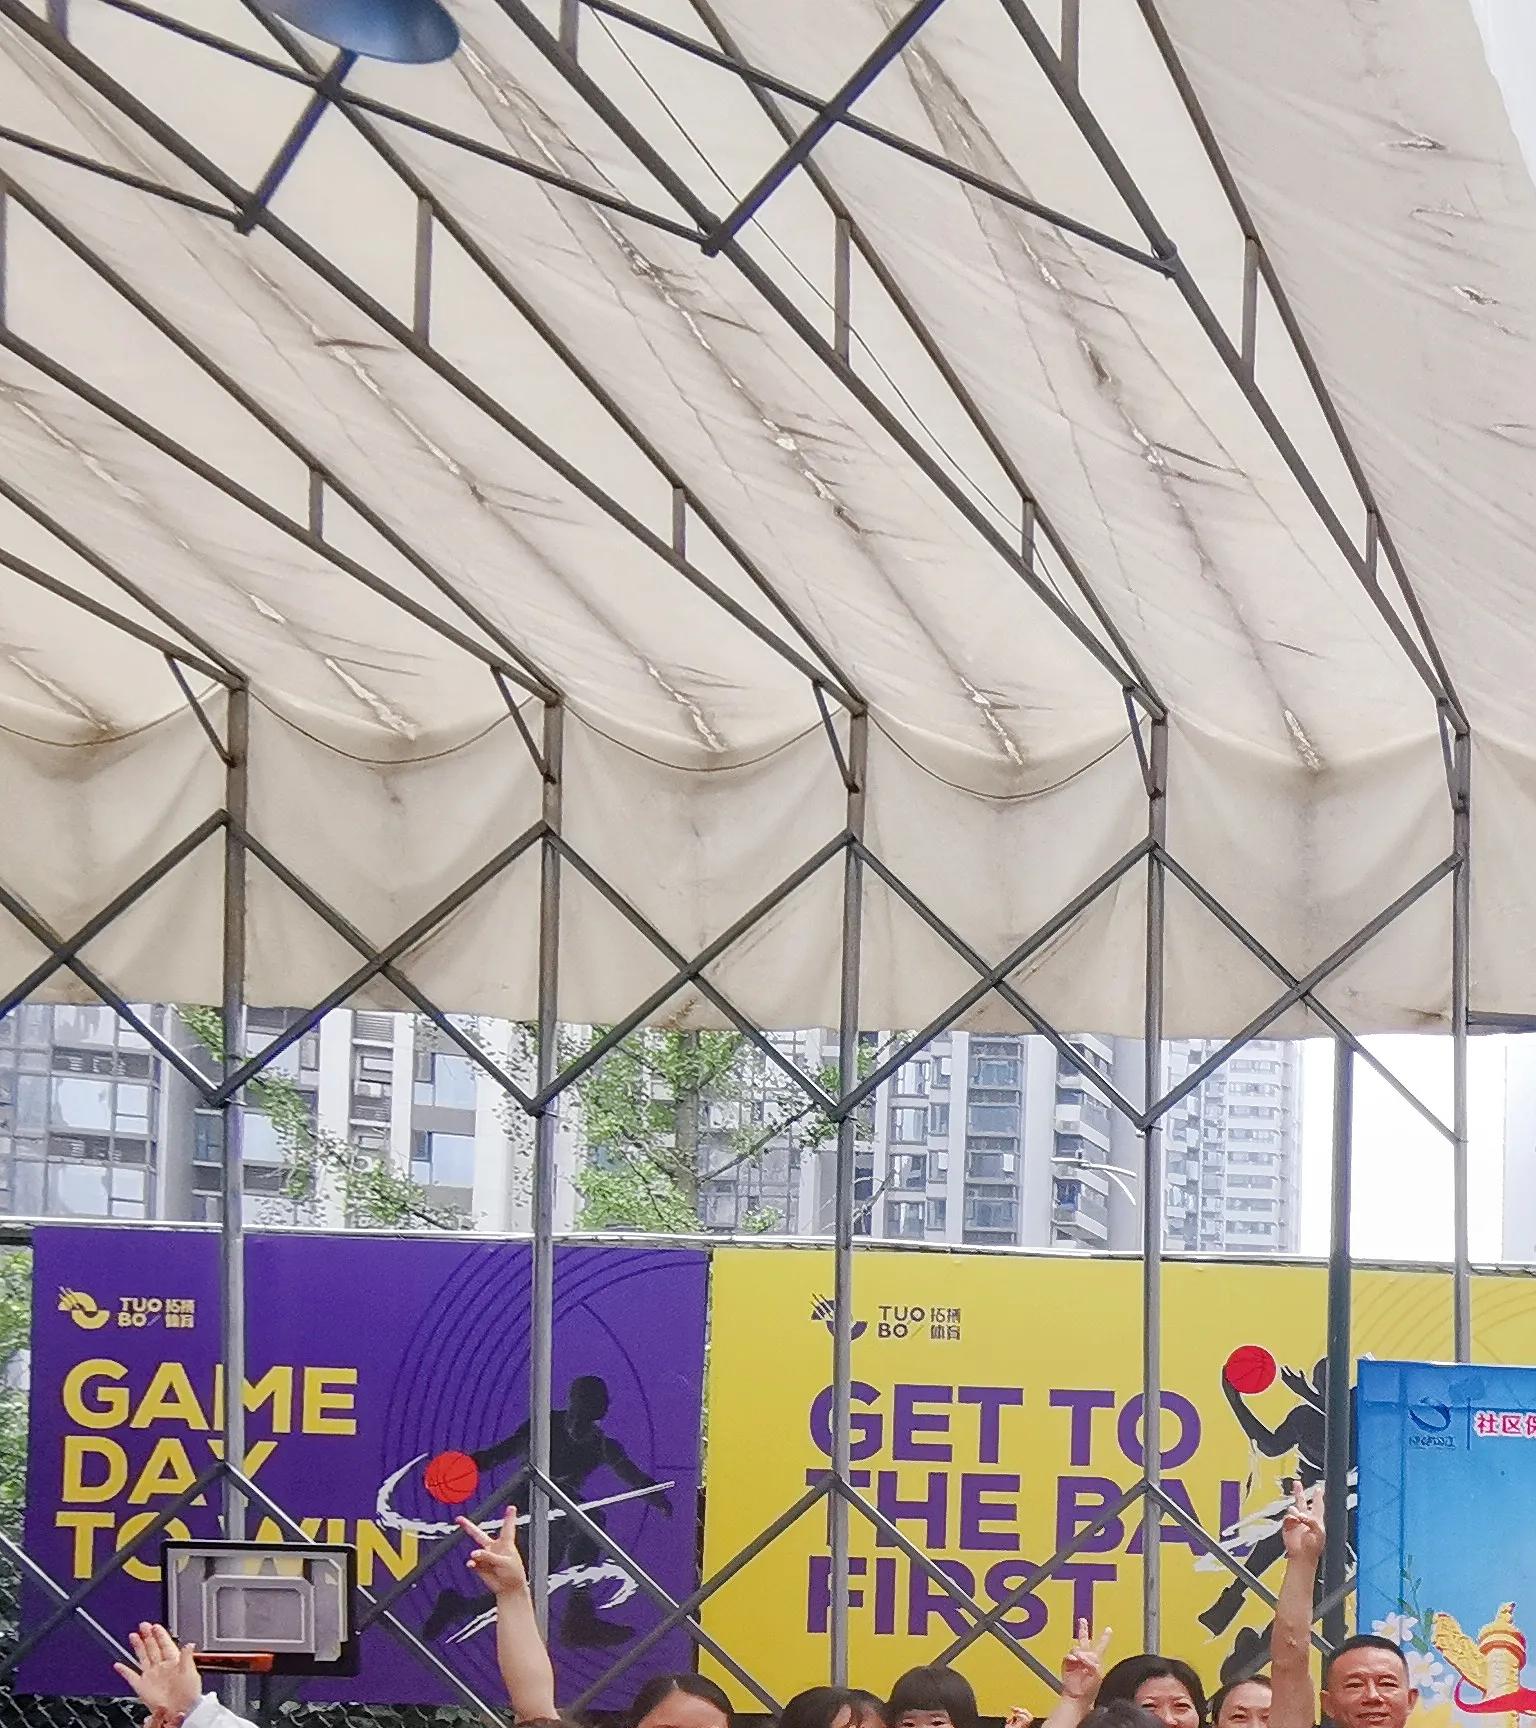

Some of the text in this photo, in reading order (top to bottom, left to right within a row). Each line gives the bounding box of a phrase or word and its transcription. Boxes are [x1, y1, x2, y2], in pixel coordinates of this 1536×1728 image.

[119, 1297, 162, 1312] TUO
[117, 1312, 147, 1327] BO
[878, 1306, 925, 1322] TUO
[878, 1322, 908, 1338] BO
[62, 1358, 359, 1435] GAME
[809, 1381, 1202, 1469] GET TO
[807, 1555, 1117, 1640] FIRST
